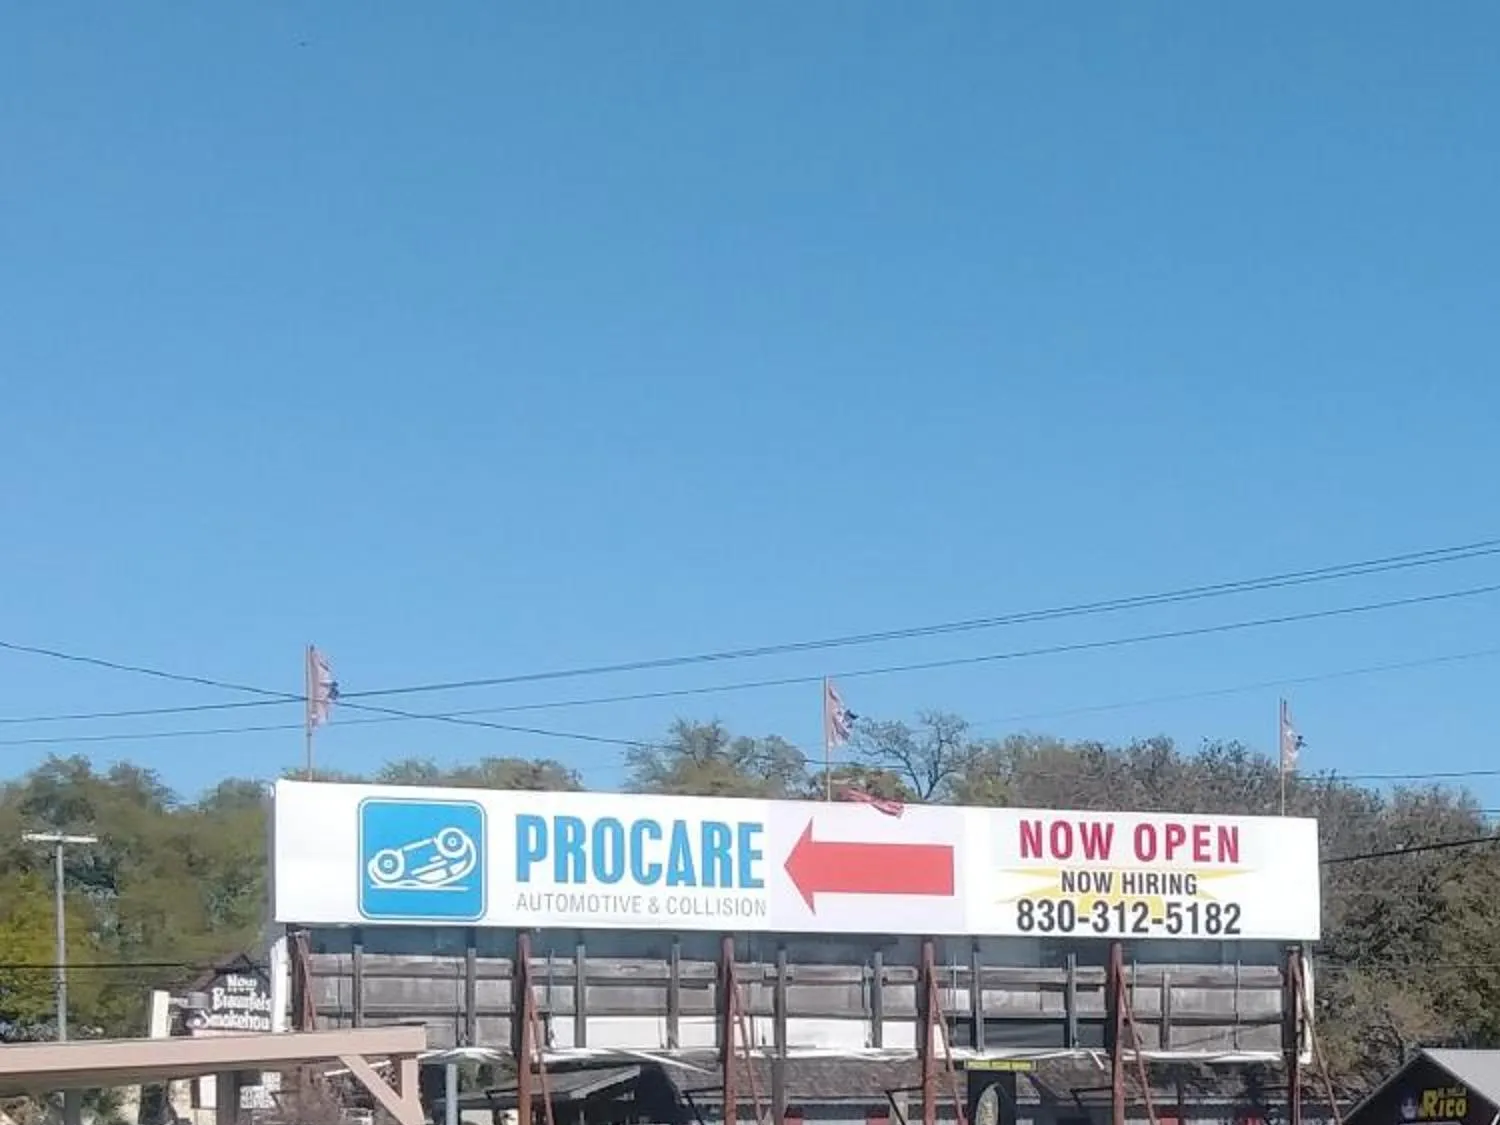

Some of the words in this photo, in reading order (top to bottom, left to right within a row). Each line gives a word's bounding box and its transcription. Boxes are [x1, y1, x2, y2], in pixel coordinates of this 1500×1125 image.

[515, 813, 765, 888] PROCARE
[1019, 820, 1114, 860] NOW
[1134, 823, 1239, 863] OPEN
[1061, 871, 1113, 893] NOW
[1122, 872, 1197, 895] HIRING
[516, 892, 642, 914] AUTOMOTIVE
[647, 895, 660, 915] &
[666, 895, 767, 917] COLLISION
[1017, 899, 1241, 934] 830-312-5182
